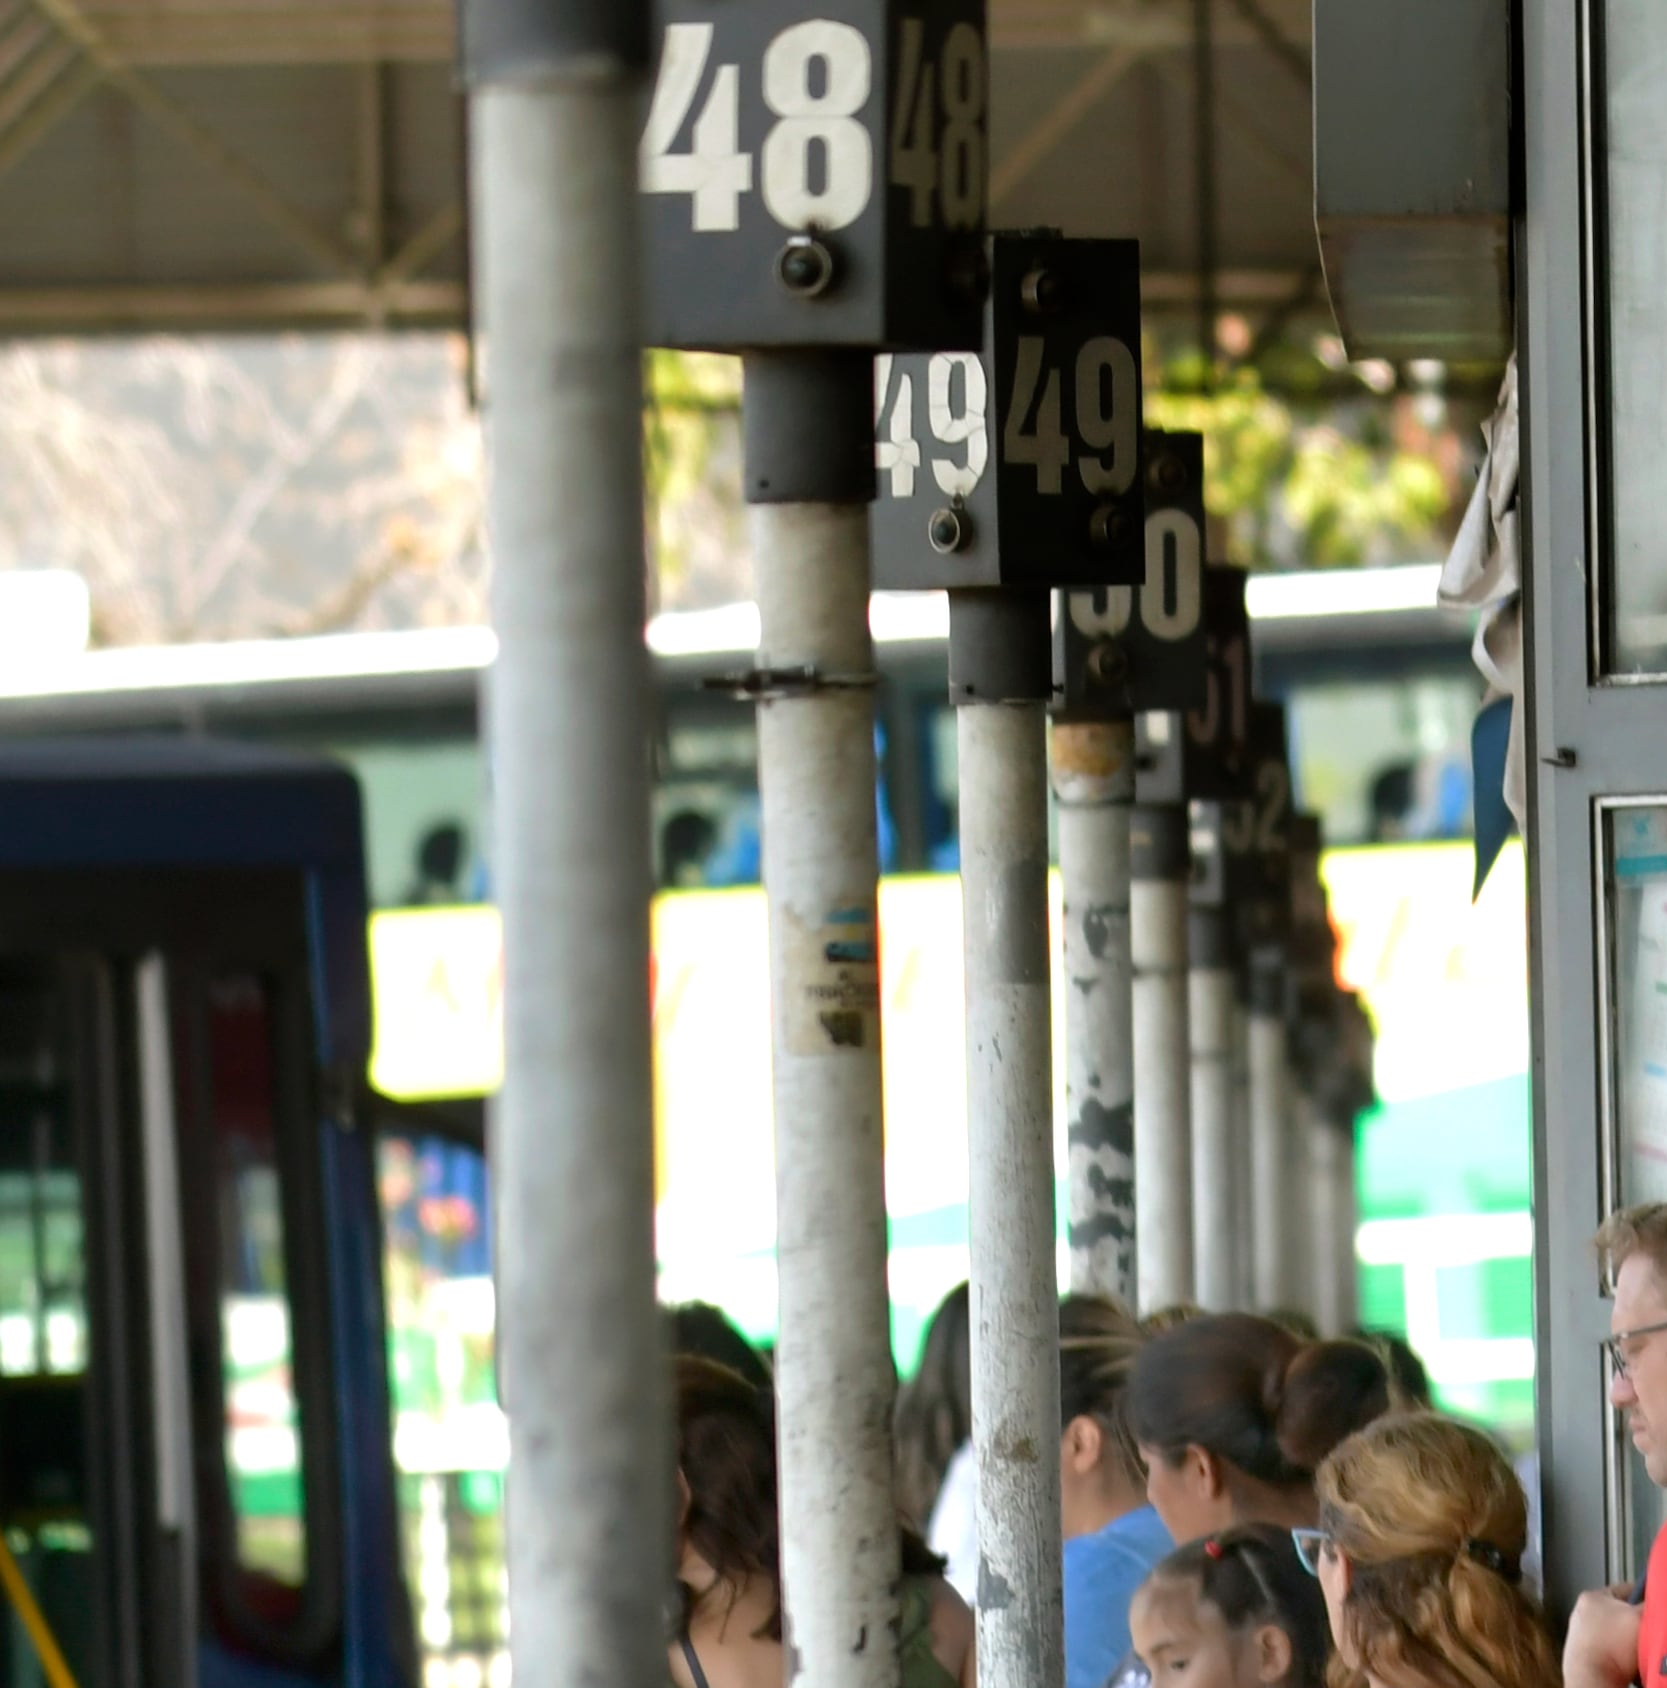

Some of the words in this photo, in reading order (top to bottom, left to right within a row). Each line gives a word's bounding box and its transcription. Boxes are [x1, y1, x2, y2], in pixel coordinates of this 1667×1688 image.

[640, 18, 873, 233] 48
[887, 18, 988, 229] 48
[875, 351, 988, 498] 49
[1004, 336, 1138, 496] 49
